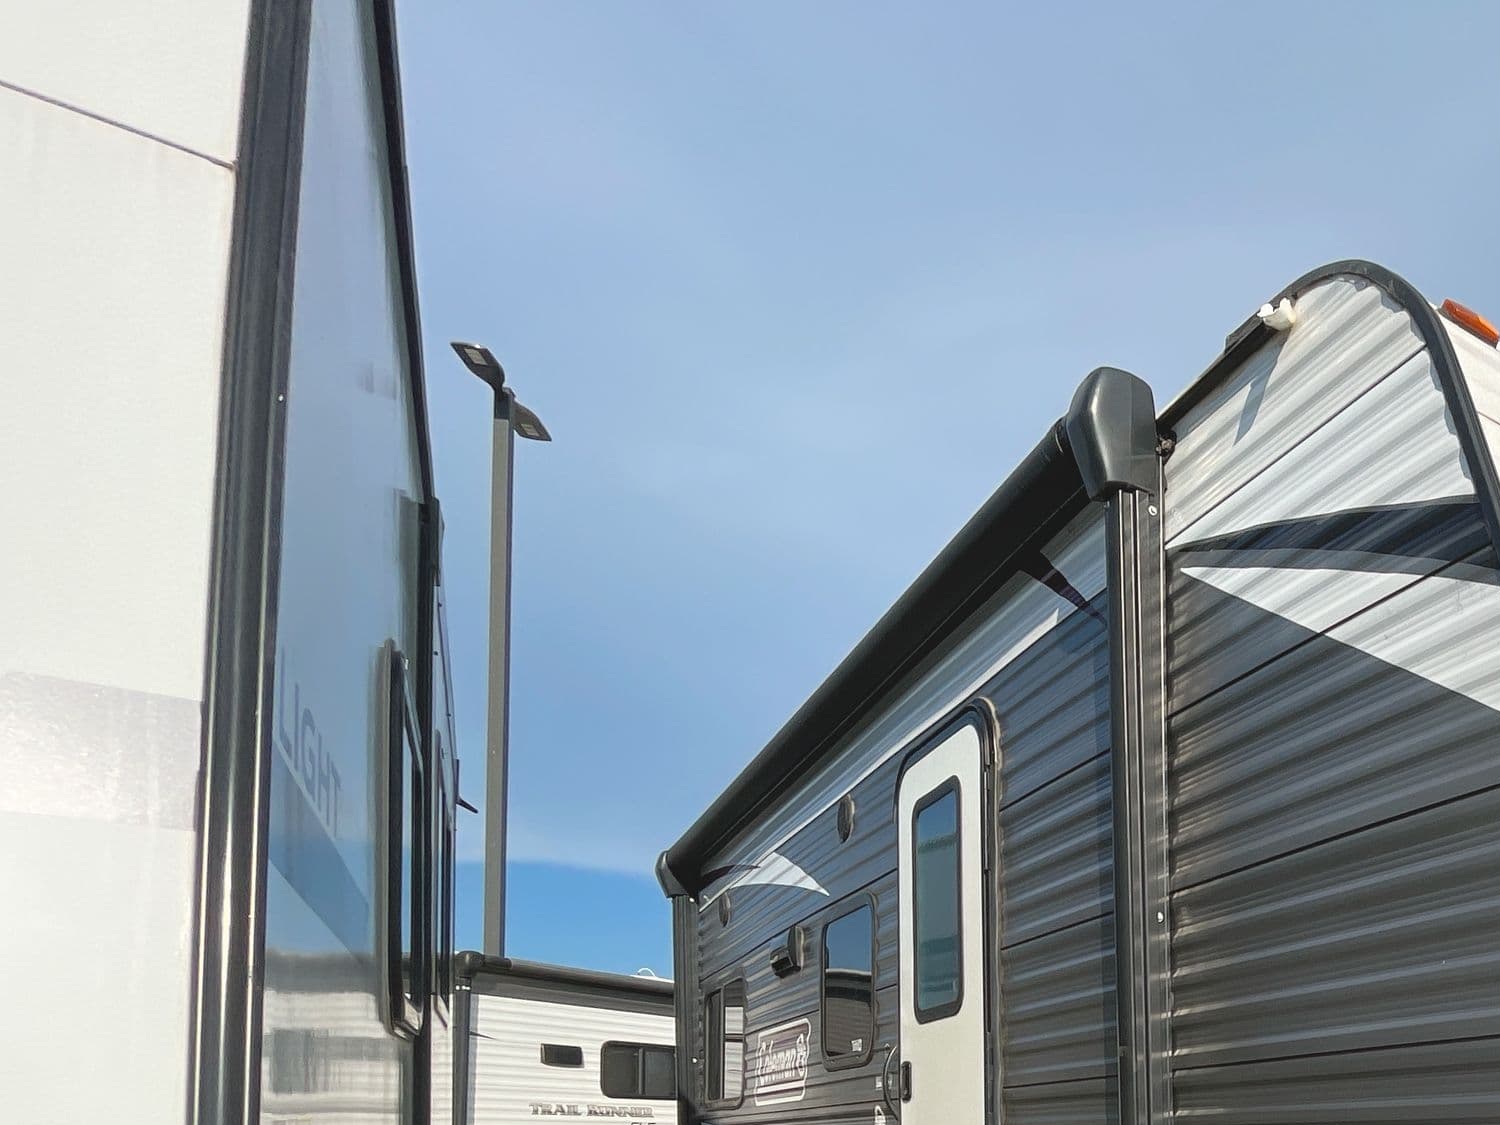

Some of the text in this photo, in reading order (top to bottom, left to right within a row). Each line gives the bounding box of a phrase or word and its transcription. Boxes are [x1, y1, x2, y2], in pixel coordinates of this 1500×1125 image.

[279, 648, 342, 837] LIGHT
[758, 1040, 797, 1087] Coleman
[529, 1103, 655, 1118] TRAIL RUNNER
